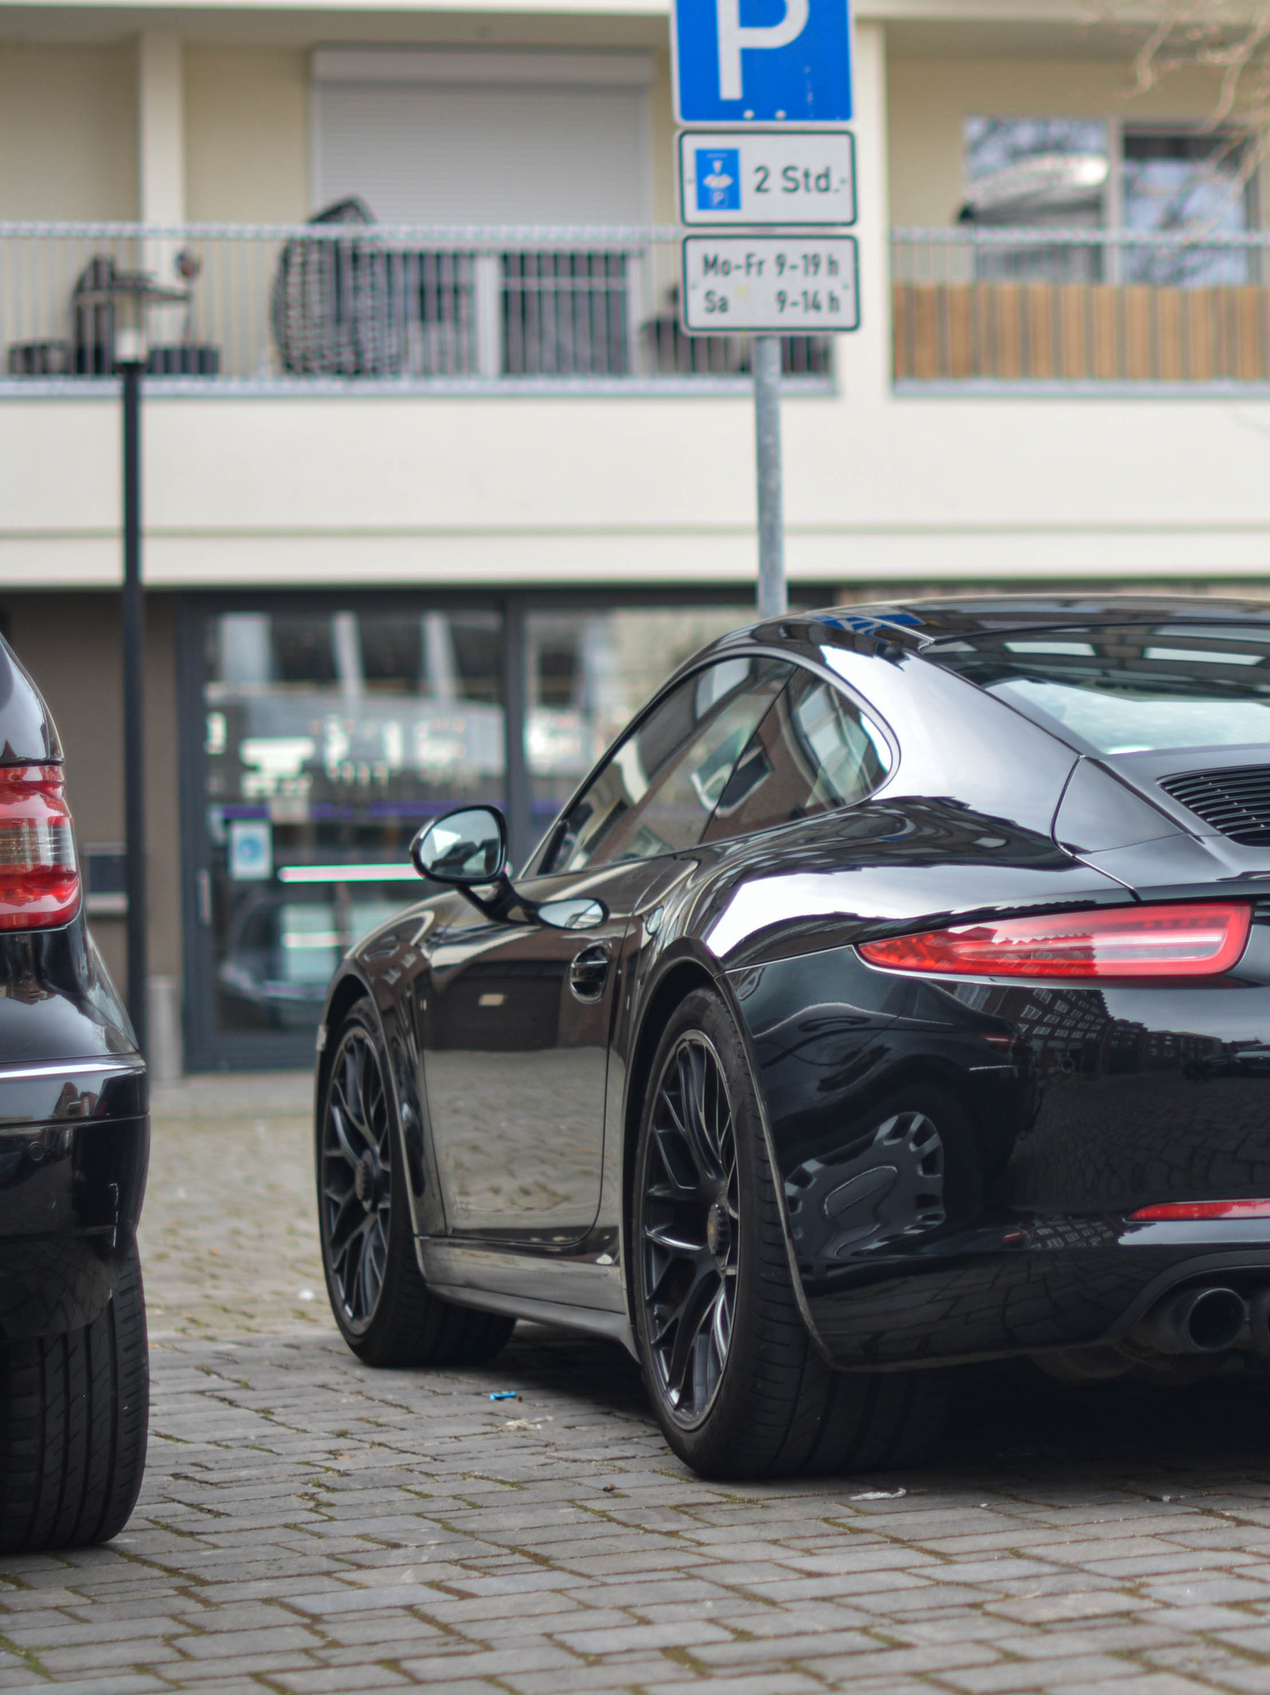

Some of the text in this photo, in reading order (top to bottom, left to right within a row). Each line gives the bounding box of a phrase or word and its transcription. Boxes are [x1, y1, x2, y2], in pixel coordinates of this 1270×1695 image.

[717, 0, 810, 100] P
[754, 166, 840, 193] 2 Std.
[703, 253, 839, 276] Mo-Fr 9-19 h
[704, 290, 840, 313] Sa 9-14 h
